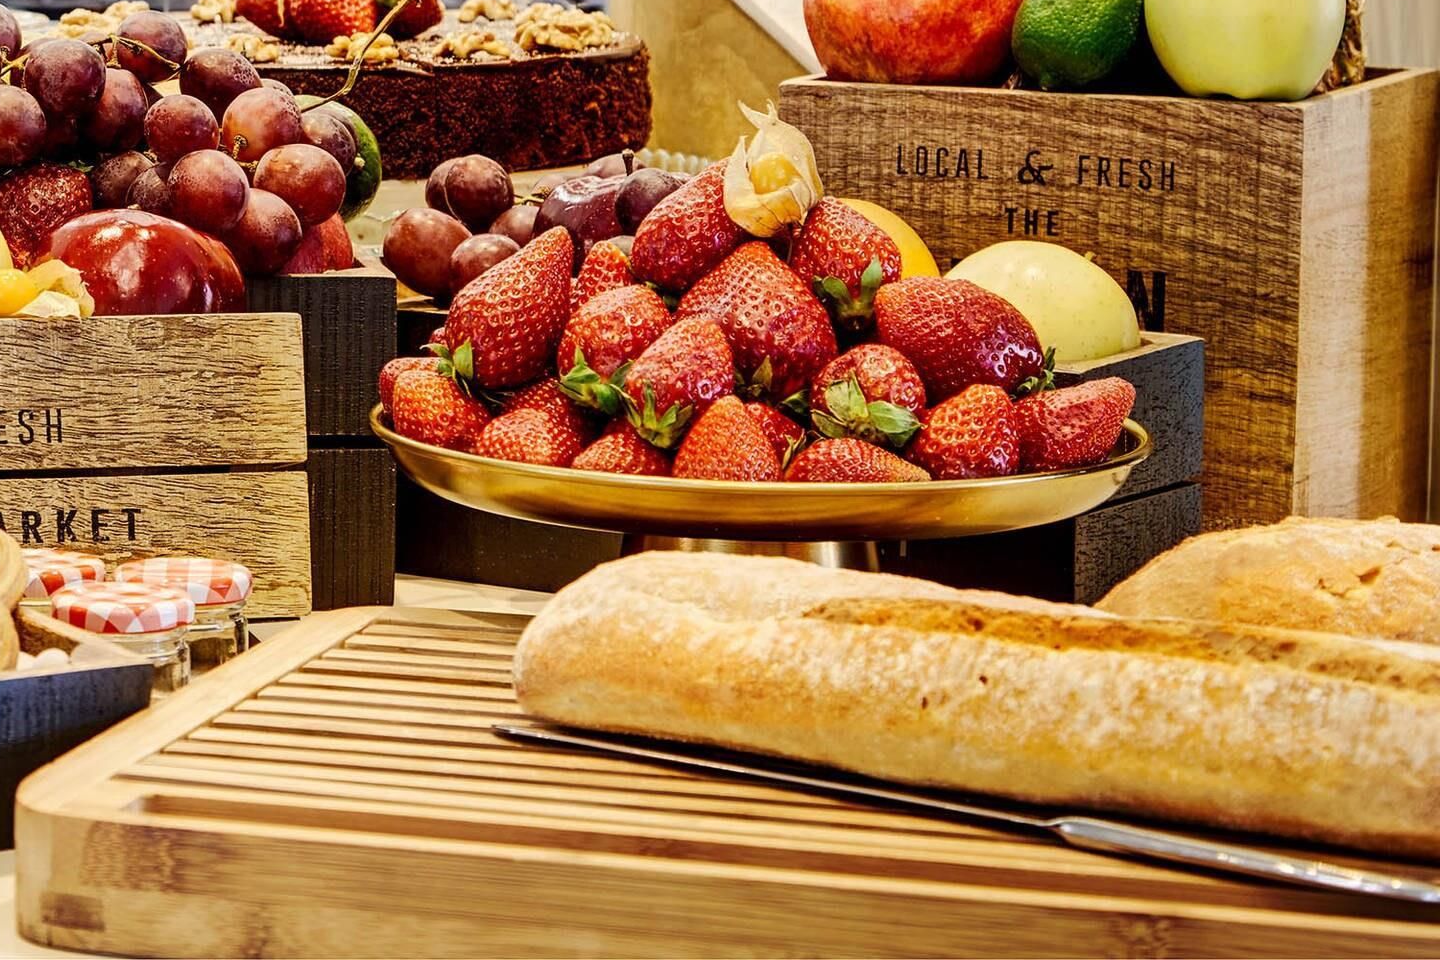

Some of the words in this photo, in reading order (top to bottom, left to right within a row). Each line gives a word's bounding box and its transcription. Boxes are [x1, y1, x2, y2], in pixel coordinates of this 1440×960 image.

[896, 144, 989, 180] LOCAL
[1017, 150, 1054, 186] &
[1077, 154, 1175, 191] FRESH
[1005, 207, 1059, 236] THE
